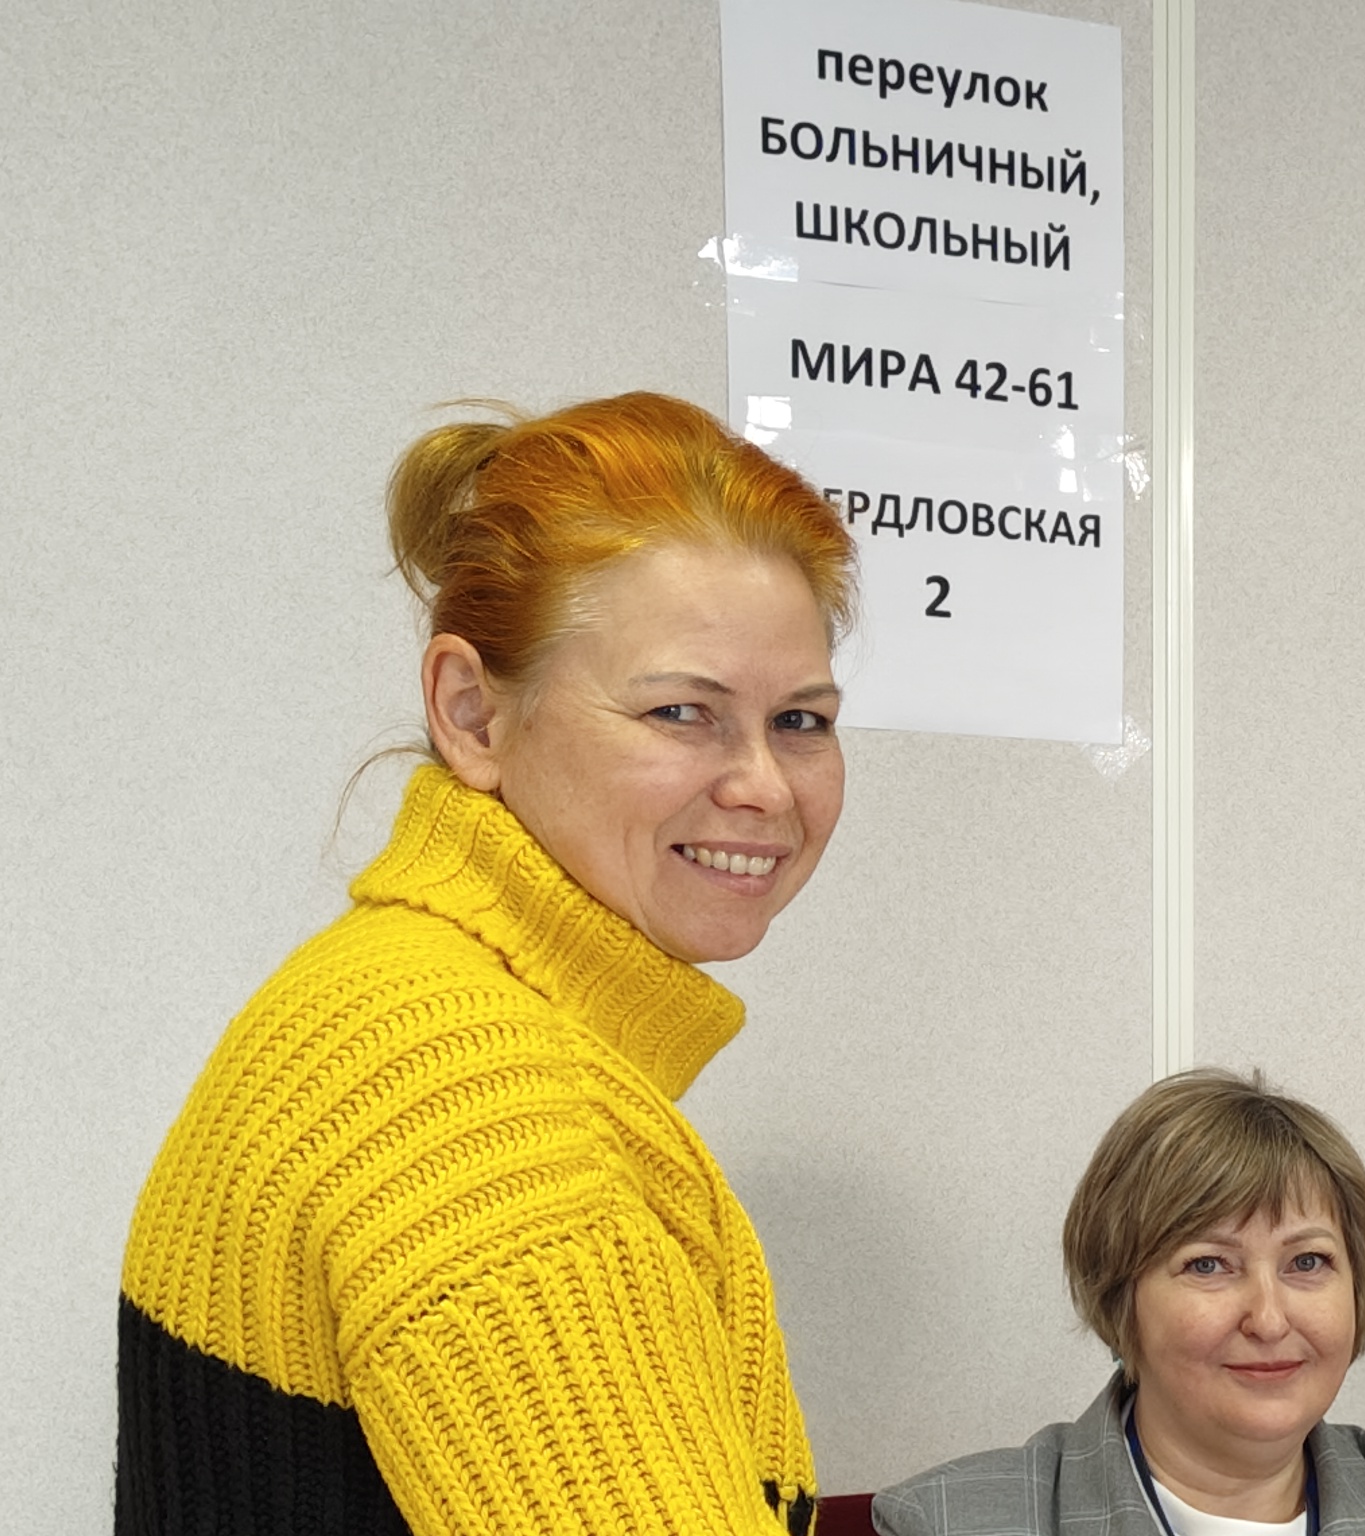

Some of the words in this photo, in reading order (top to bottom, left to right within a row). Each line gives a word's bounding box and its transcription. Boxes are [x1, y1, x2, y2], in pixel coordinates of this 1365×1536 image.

[817, 48, 1049, 113] переулок
[761, 116, 1101, 206] БОЛЬНИЧНЫЙ,
[795, 201, 1071, 272] ШКОЛЬНЫЙ
[791, 338, 941, 396] МИРА
[954, 359, 1080, 411] 42-61
[924, 575, 952, 618] 2
